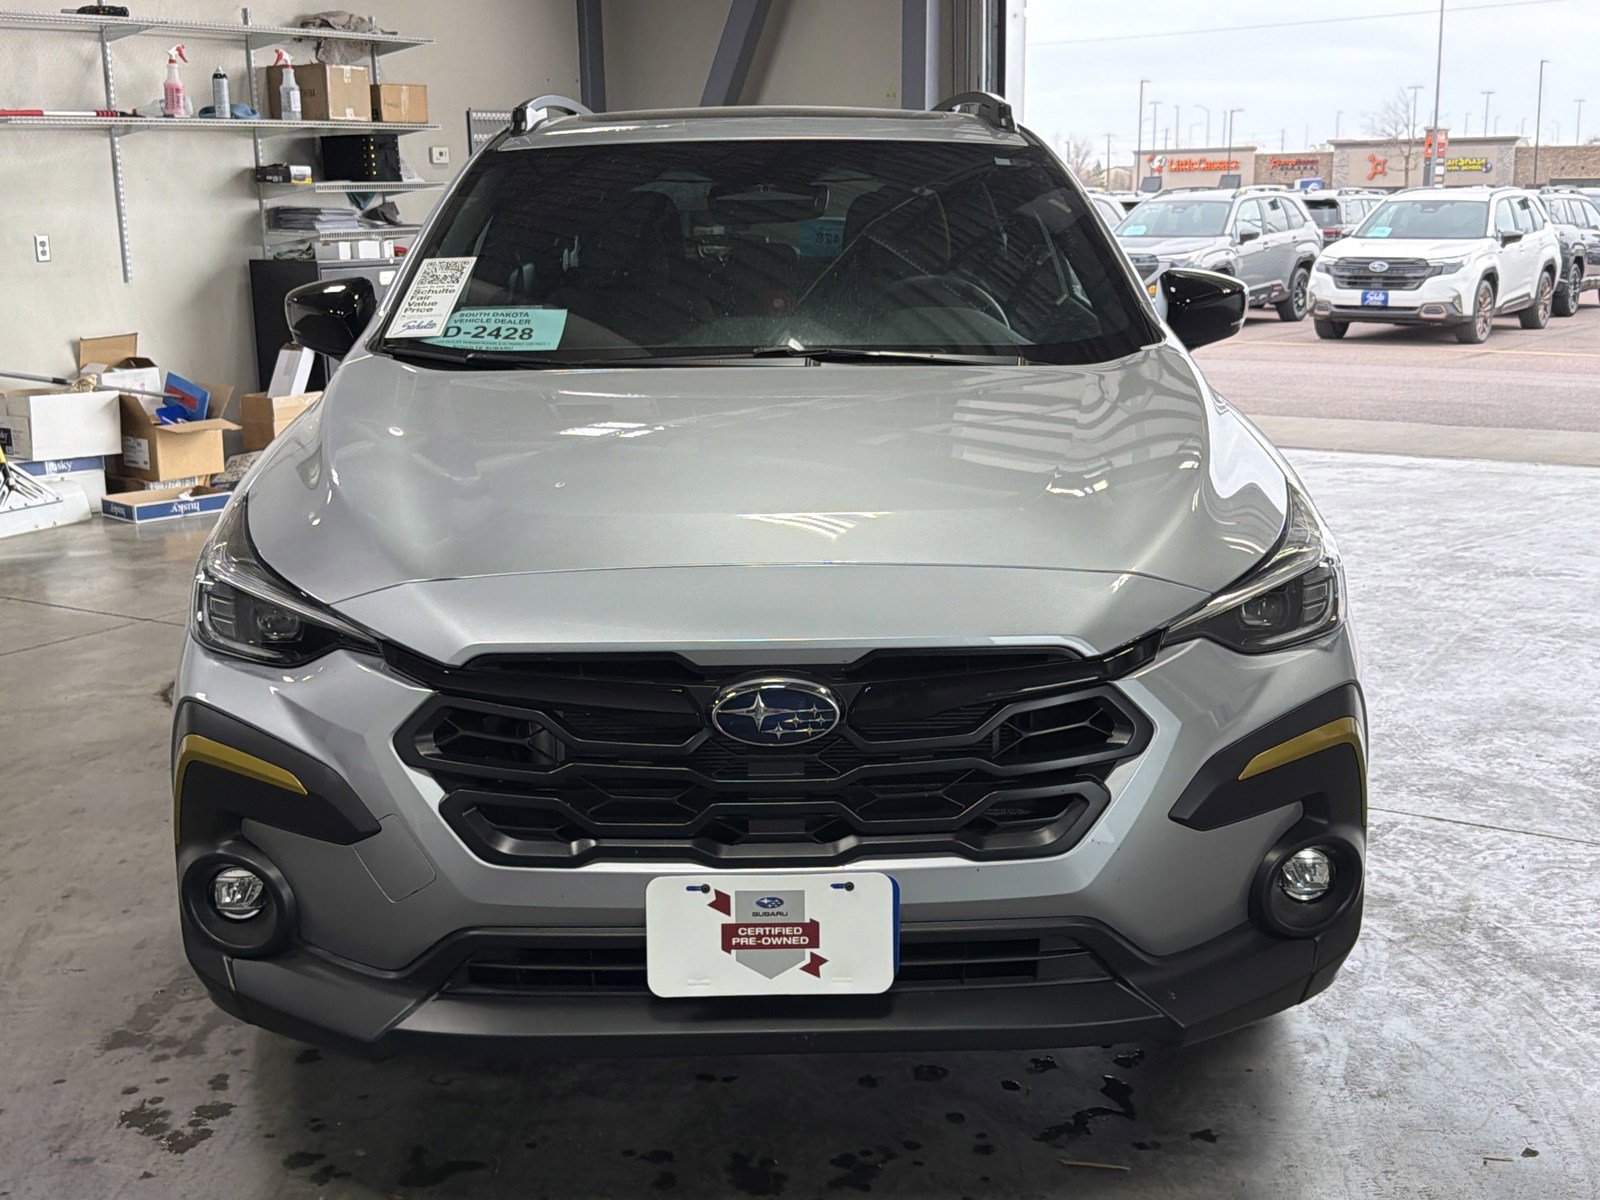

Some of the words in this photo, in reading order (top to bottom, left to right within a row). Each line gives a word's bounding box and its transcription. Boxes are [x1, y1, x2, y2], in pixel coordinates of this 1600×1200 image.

[442, 325, 534, 341] D-2428
[170, 501, 201, 514] husky
[738, 927, 803, 936] CERTIFIED
[732, 936, 810, 946] PRE-OWNED
